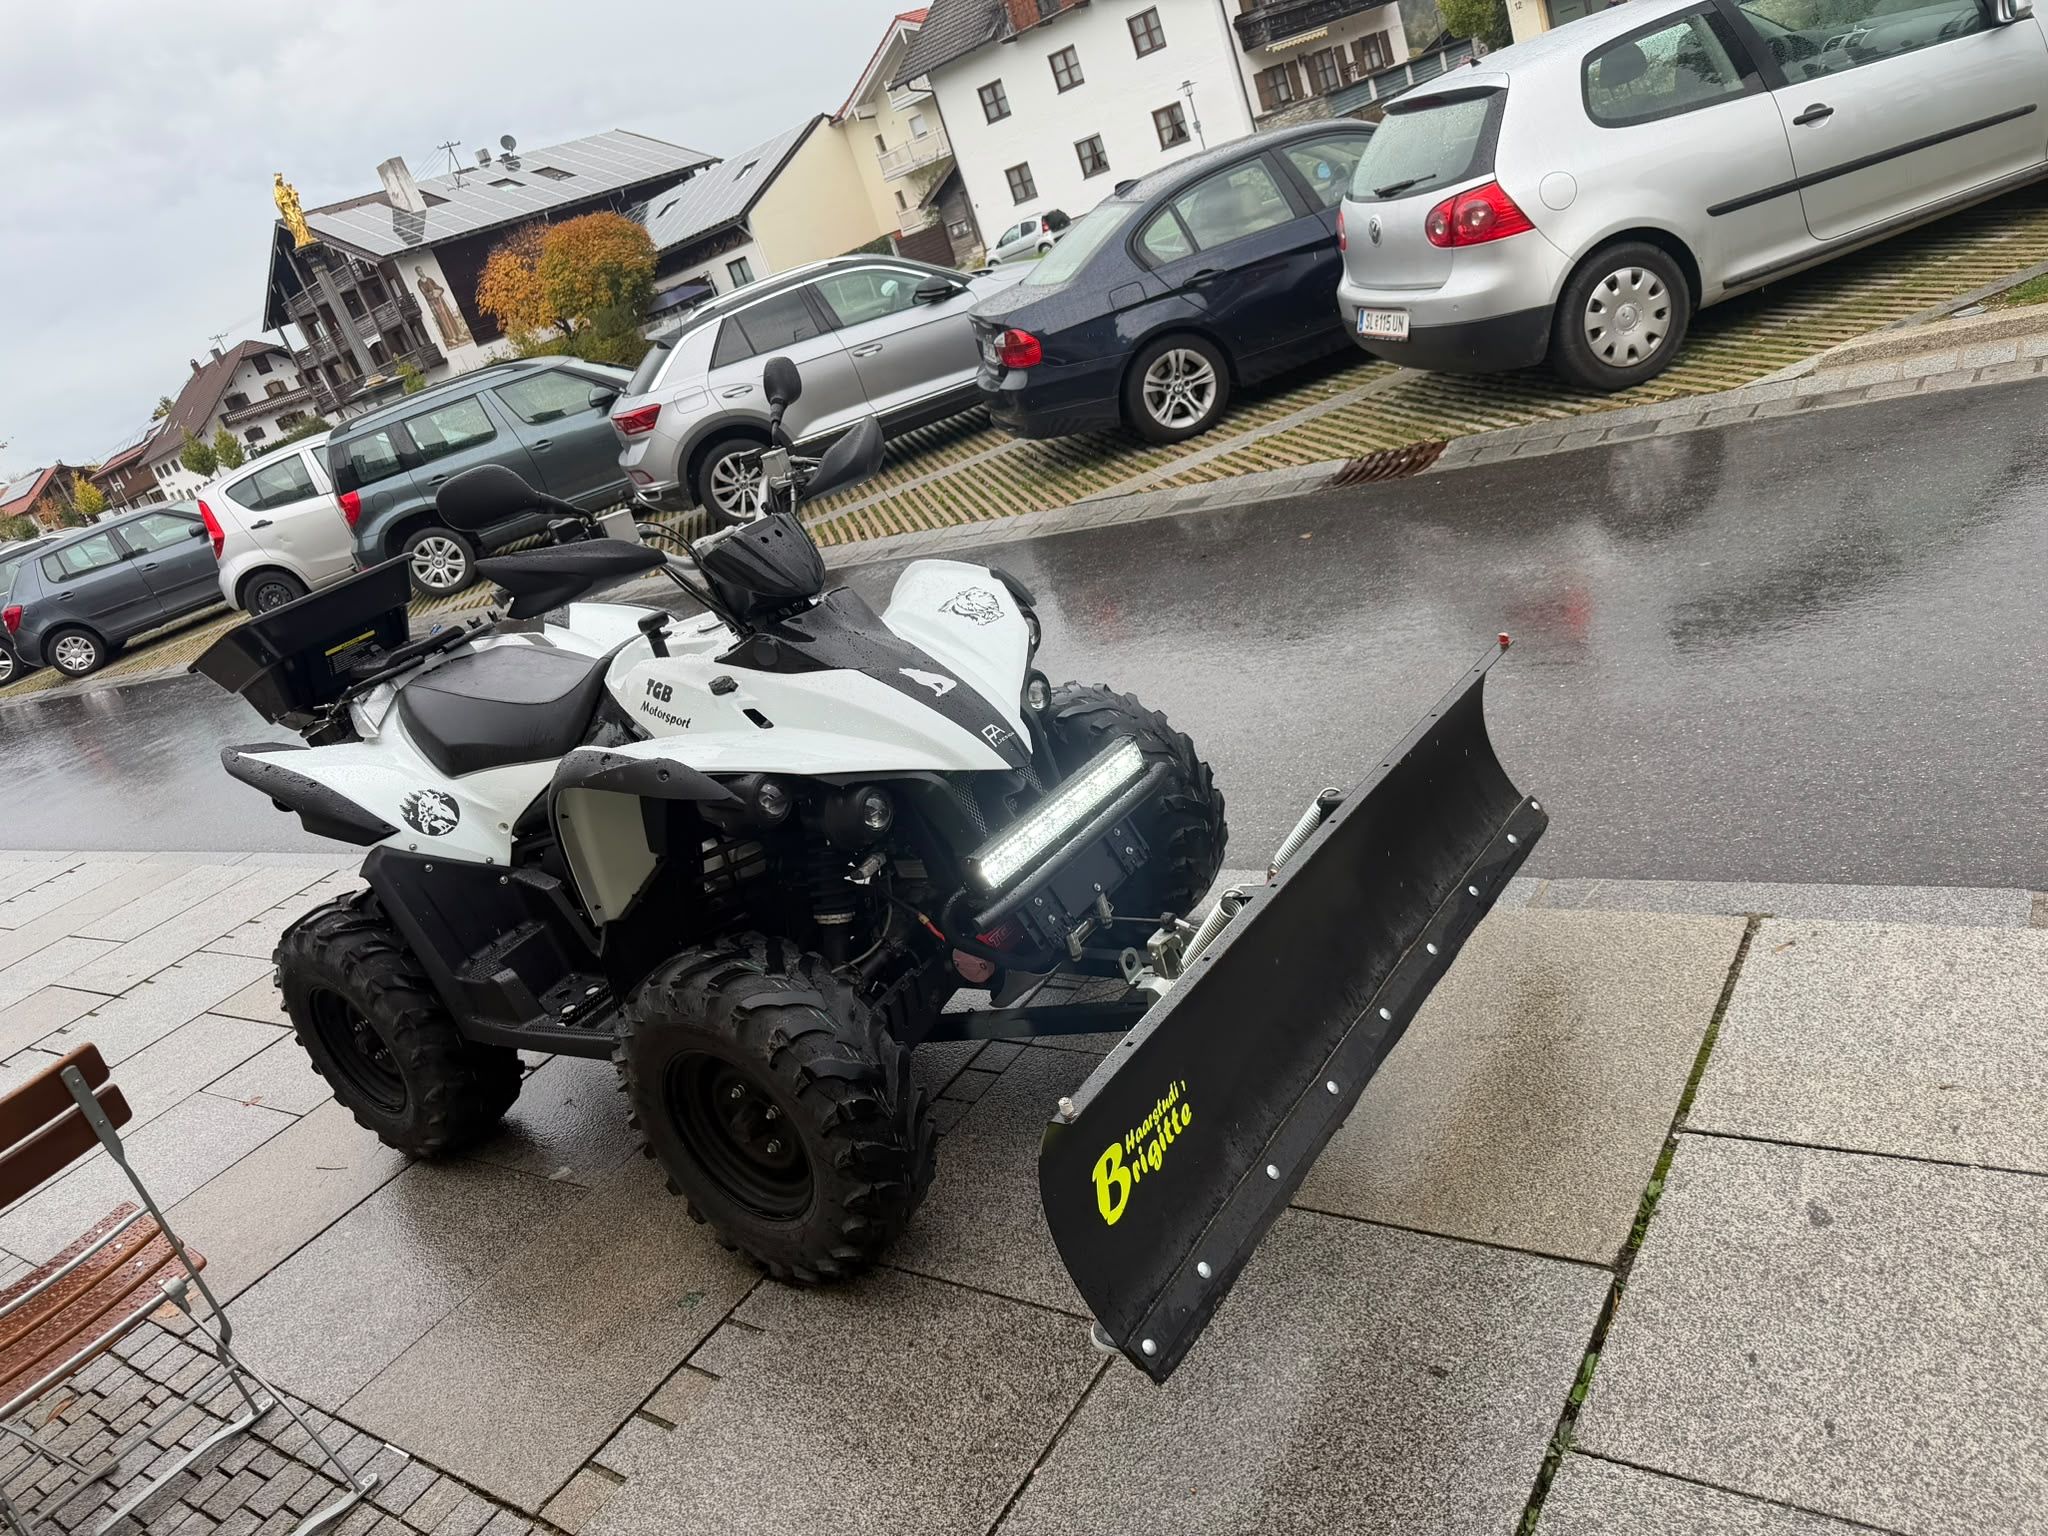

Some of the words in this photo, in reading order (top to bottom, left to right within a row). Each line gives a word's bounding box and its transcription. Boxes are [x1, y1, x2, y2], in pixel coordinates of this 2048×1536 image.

[1514, 1, 1523, 10] 12
[1365, 312, 1373, 330] SL
[646, 678, 673, 703] TGB
[640, 700, 691, 729] Motorsport
[1091, 1102, 1192, 1226] Brigitte
